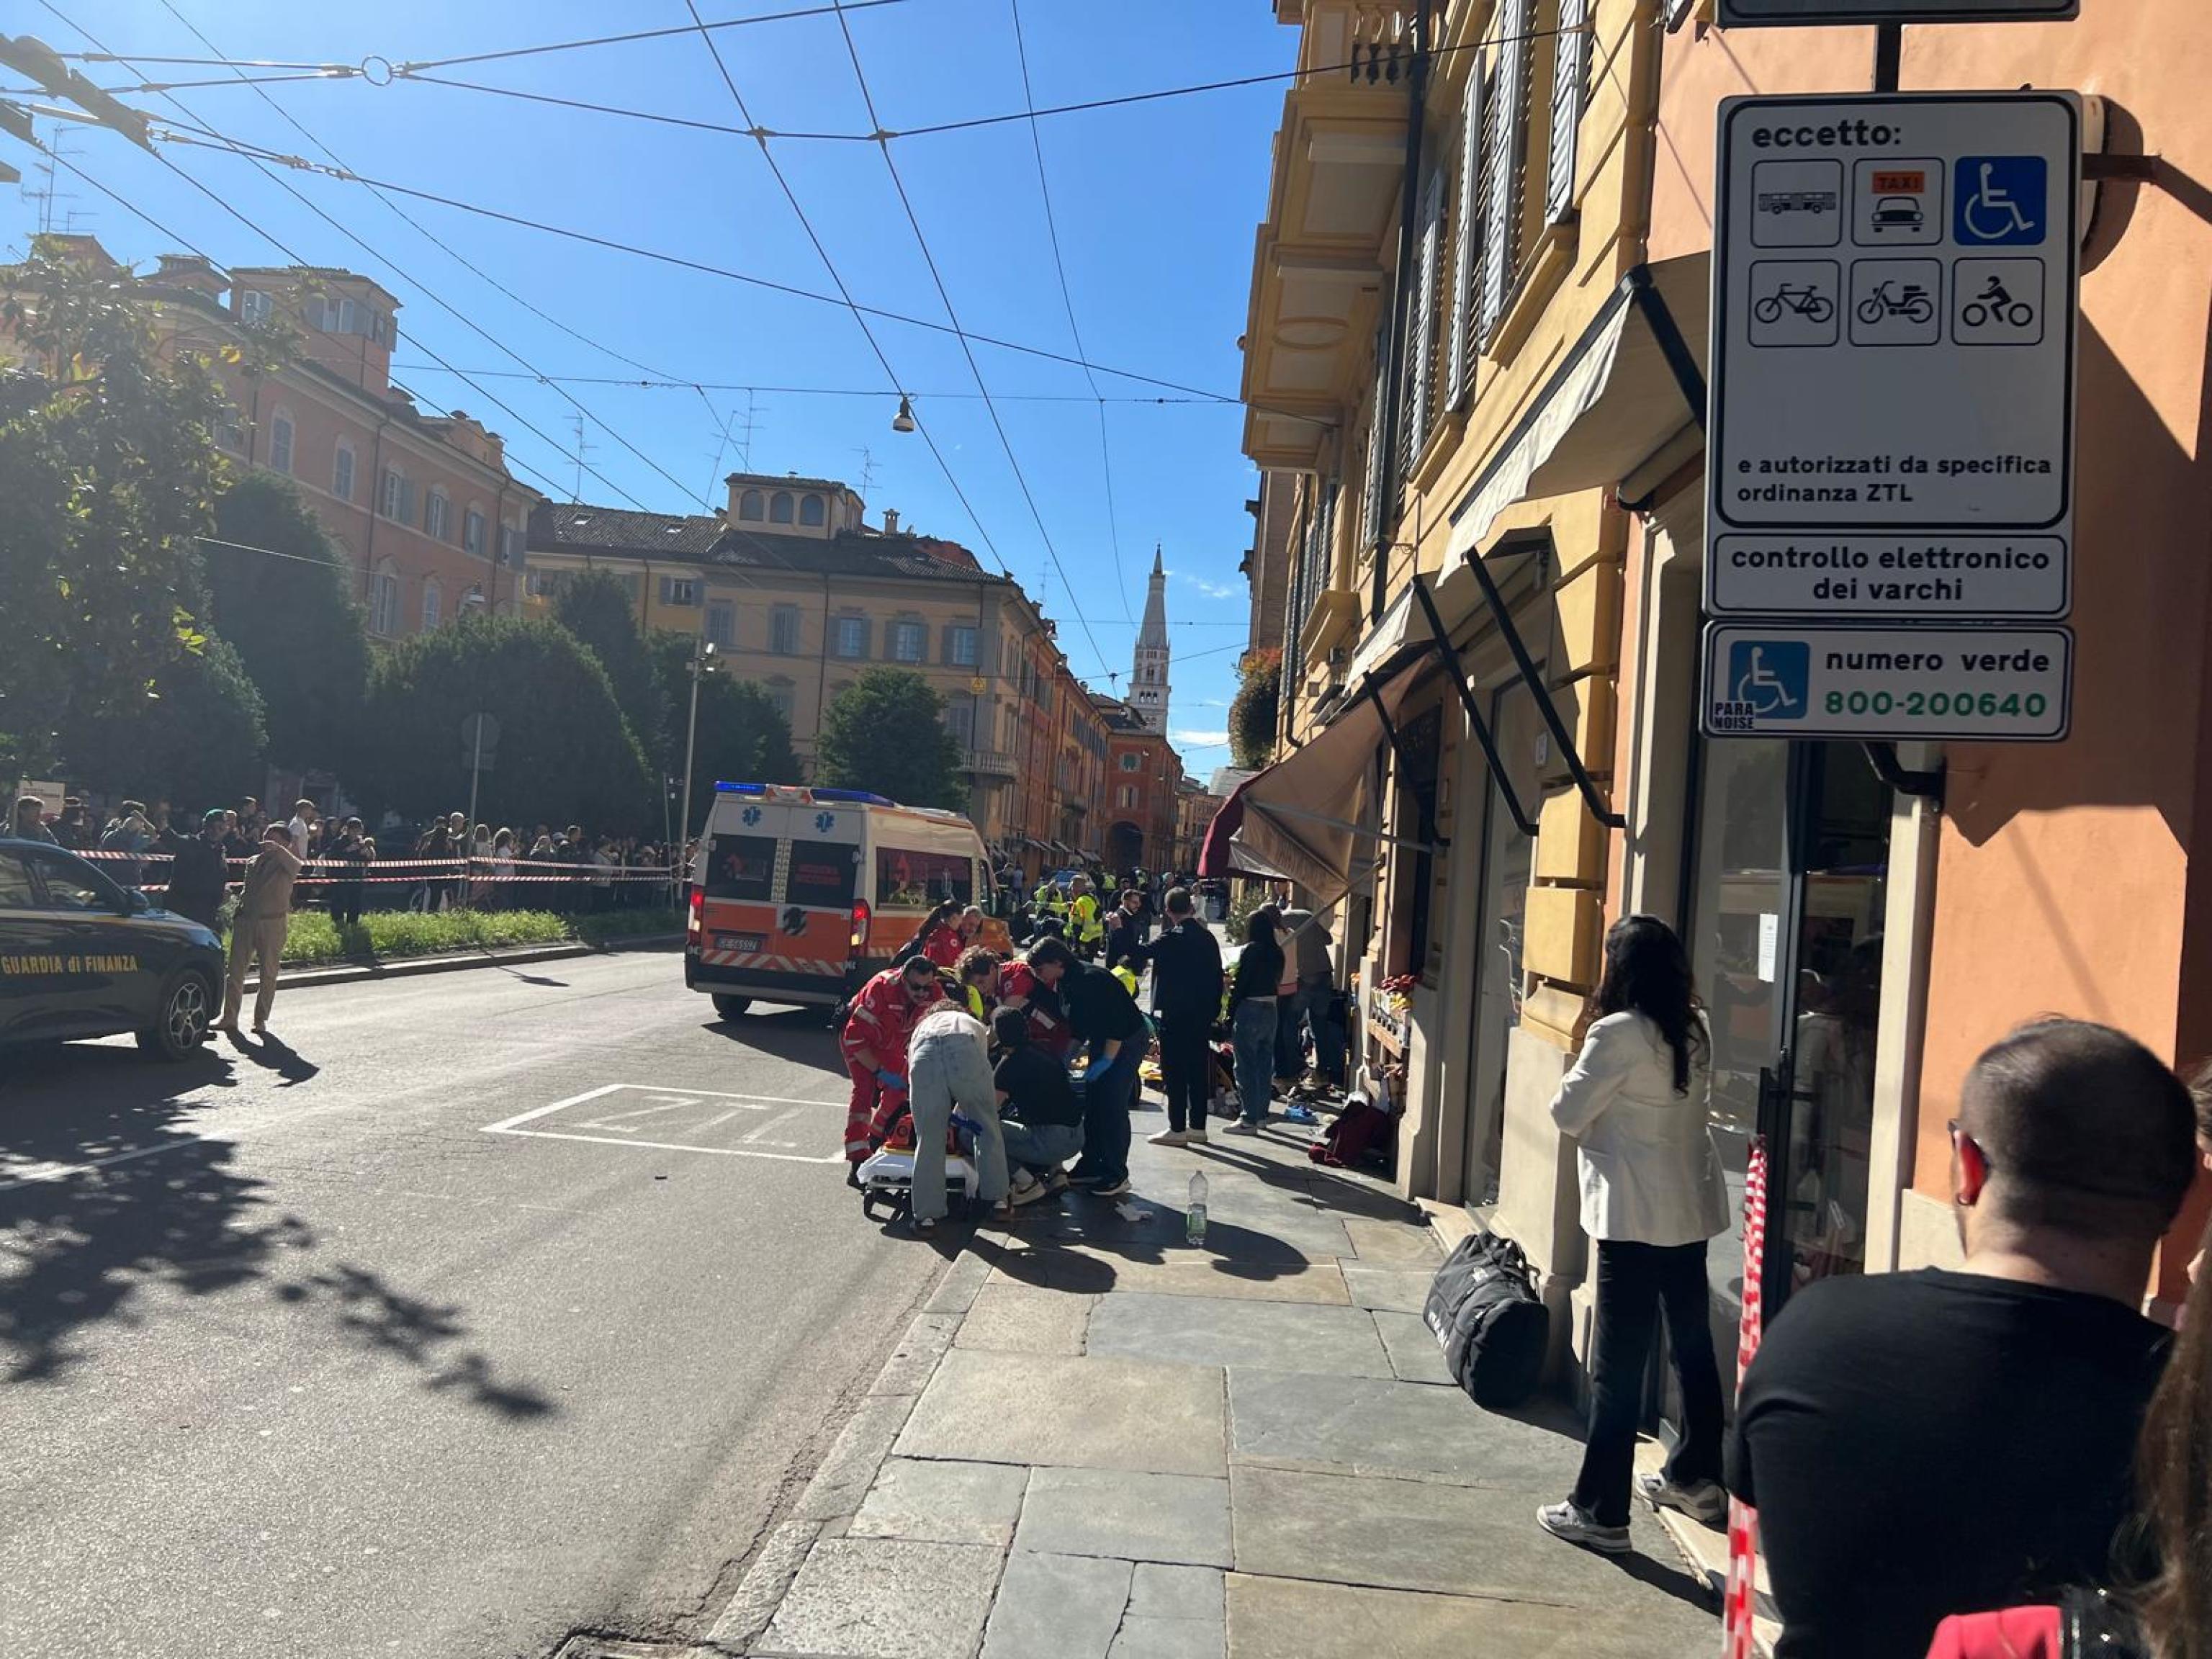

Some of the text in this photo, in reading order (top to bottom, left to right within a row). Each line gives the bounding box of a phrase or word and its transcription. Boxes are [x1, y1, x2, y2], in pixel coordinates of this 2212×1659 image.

[1752, 120, 1901, 147] eccetto:
[1878, 176, 1918, 189] TAXI
[1737, 454, 2051, 477] e autorizzati da specifica
[1737, 483, 1913, 502] ordinanza ZTL
[1731, 546, 2049, 570] controllo elettronico
[1813, 578, 1963, 601] dei varchi
[1825, 650, 2050, 672] numero verde
[1715, 702, 1753, 715] PARA
[1825, 691, 2046, 717] 800-200640
[1714, 717, 1754, 729] NOISE
[1, 954, 138, 974] GUARDIA di FINANZA
[573, 1095, 806, 1147] ZTL
